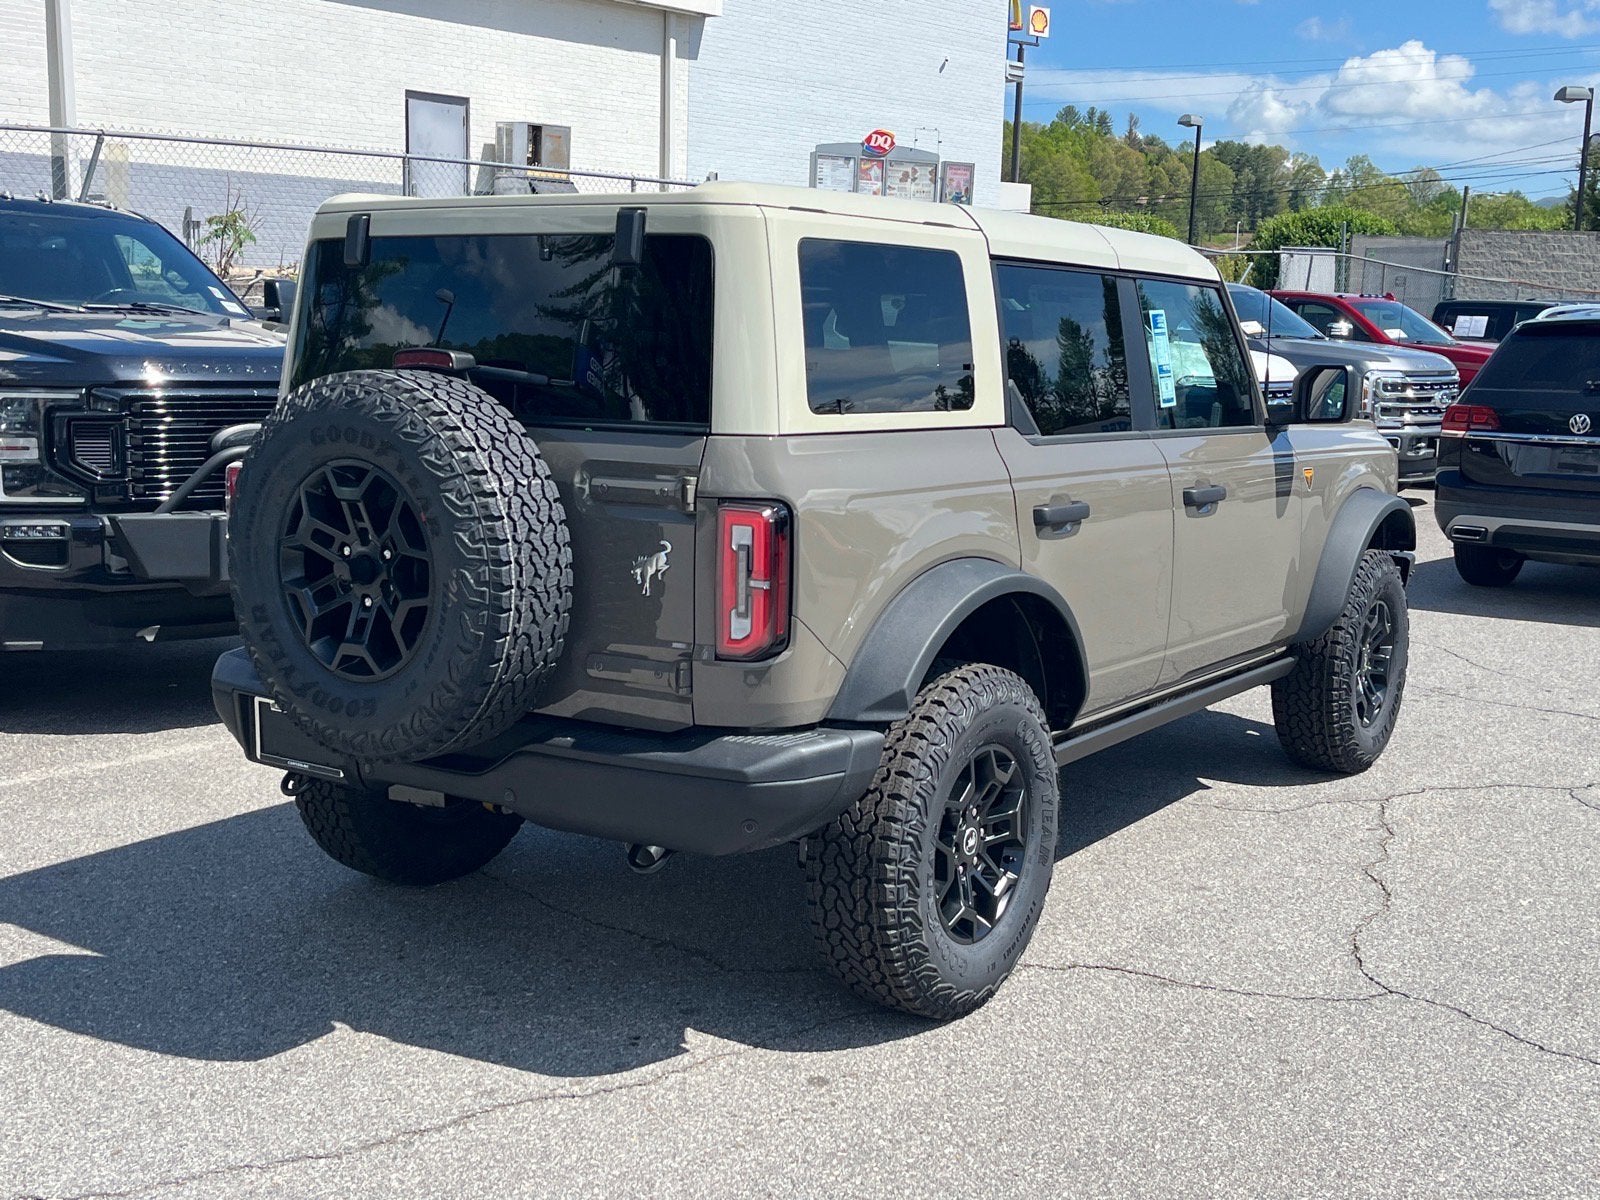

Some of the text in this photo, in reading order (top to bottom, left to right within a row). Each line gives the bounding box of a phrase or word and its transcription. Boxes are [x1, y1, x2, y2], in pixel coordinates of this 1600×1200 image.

[869, 133, 892, 150] DQ
[310, 424, 442, 538] GOODYEAR
[1015, 719, 1055, 867] GOODYEAR
